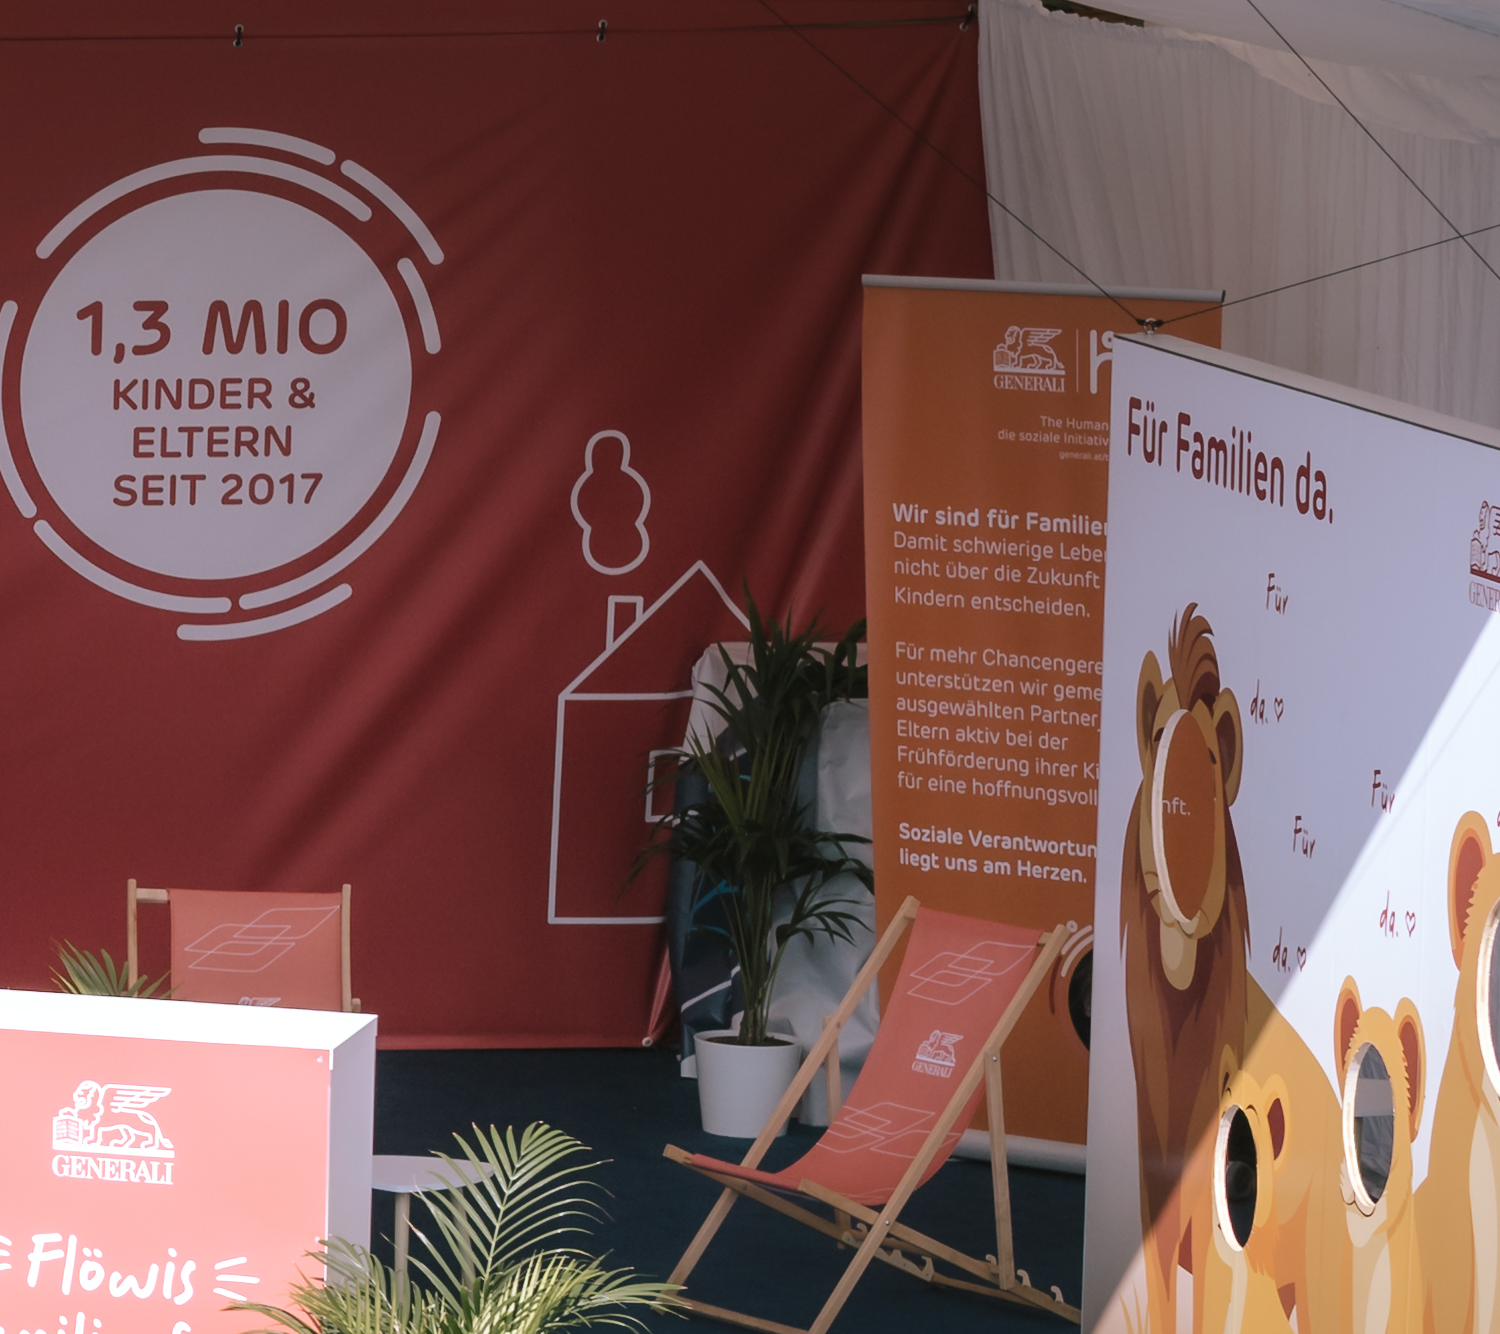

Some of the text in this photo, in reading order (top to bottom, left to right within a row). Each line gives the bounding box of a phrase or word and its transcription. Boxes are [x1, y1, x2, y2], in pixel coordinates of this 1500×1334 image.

[75, 298, 349, 365] 1,3 MIO
[112, 376, 317, 411] KINDER &
[993, 374, 1066, 393] GENERALI
[997, 429, 1016, 441] die
[1019, 431, 1061, 444] soziale
[1040, 415, 1110, 431] The Human
[132, 424, 294, 459] ELTERN
[1127, 396, 1334, 525] Für Familien da.
[112, 472, 324, 507] SEIT 2017
[892, 502, 929, 524] Wir
[935, 506, 980, 527] sind
[987, 508, 1020, 530] für
[893, 530, 948, 553] Damit
[952, 535, 1054, 562] schwierige
[894, 557, 1101, 590] nicht über die Zukunft
[894, 586, 1091, 619] Kindern entscheiden.
[1265, 572, 1289, 616] Für
[895, 640, 1104, 677] Für mehr Chancengere
[895, 670, 1016, 694] unterstützen
[1018, 678, 1049, 697] wir
[896, 696, 1026, 721] ausgewählten
[896, 719, 1069, 751] Eltern aktiv bei der
[897, 744, 1030, 777] Frühförderung
[1034, 756, 1079, 778] ihrer
[897, 770, 924, 790] für
[927, 774, 968, 795] eine
[972, 777, 1099, 807] hoffnungsvoll
[1371, 769, 1396, 816] Für
[898, 821, 1098, 859] Soziale Verantwortun
[1292, 815, 1316, 860] Für
[899, 847, 1088, 884] liegt uns am Herzen.
[911, 1058, 955, 1079] GENERALI
[51, 1154, 176, 1186] GENERALI
[26, 1232, 198, 1306] Flöwis
